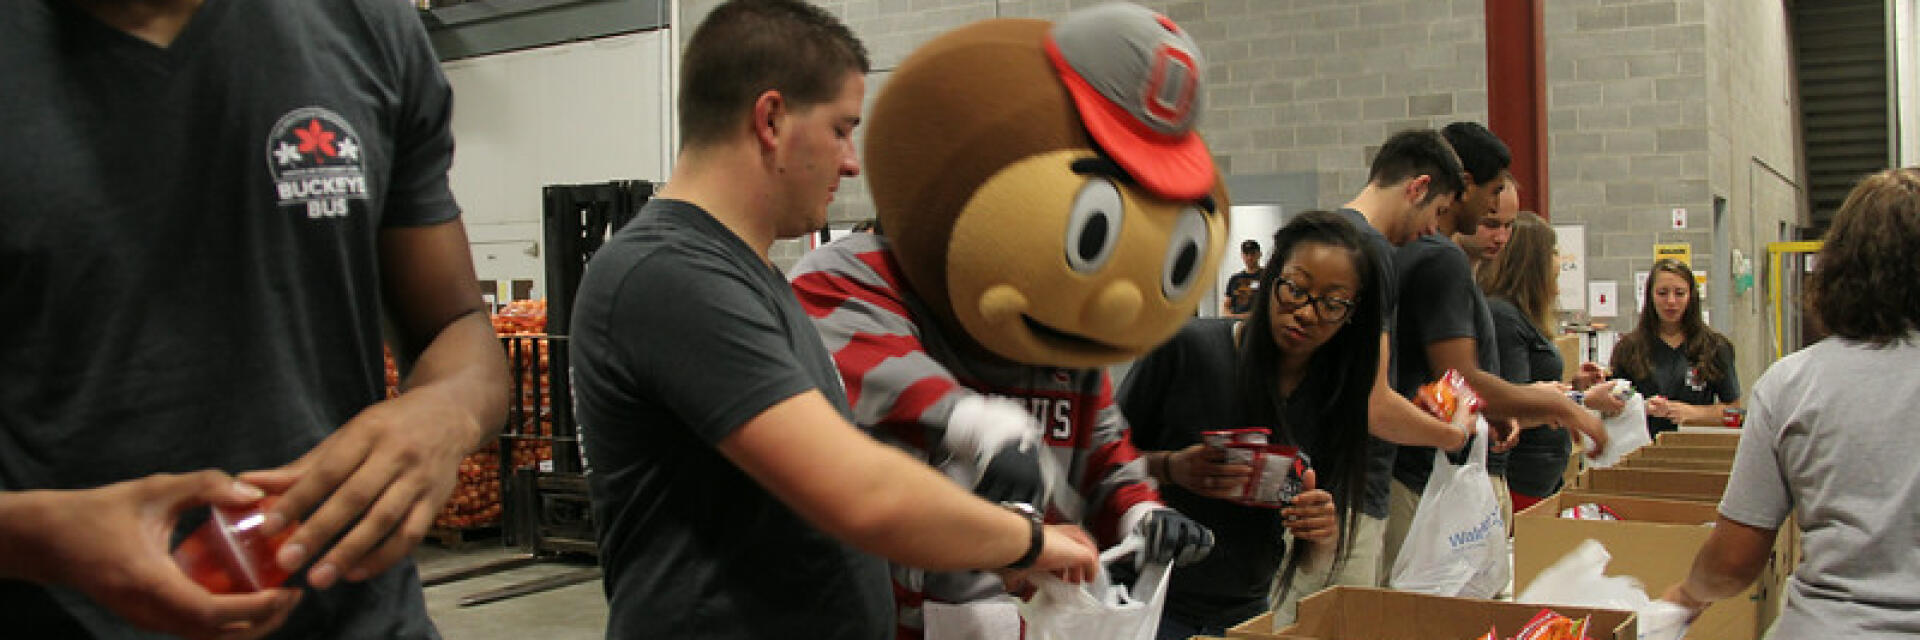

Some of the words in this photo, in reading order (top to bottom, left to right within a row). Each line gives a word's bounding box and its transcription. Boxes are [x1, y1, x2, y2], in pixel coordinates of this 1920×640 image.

[1143, 43, 1200, 127] O
[277, 176, 367, 200] BUCKEYE
[307, 197, 349, 219] BUS
